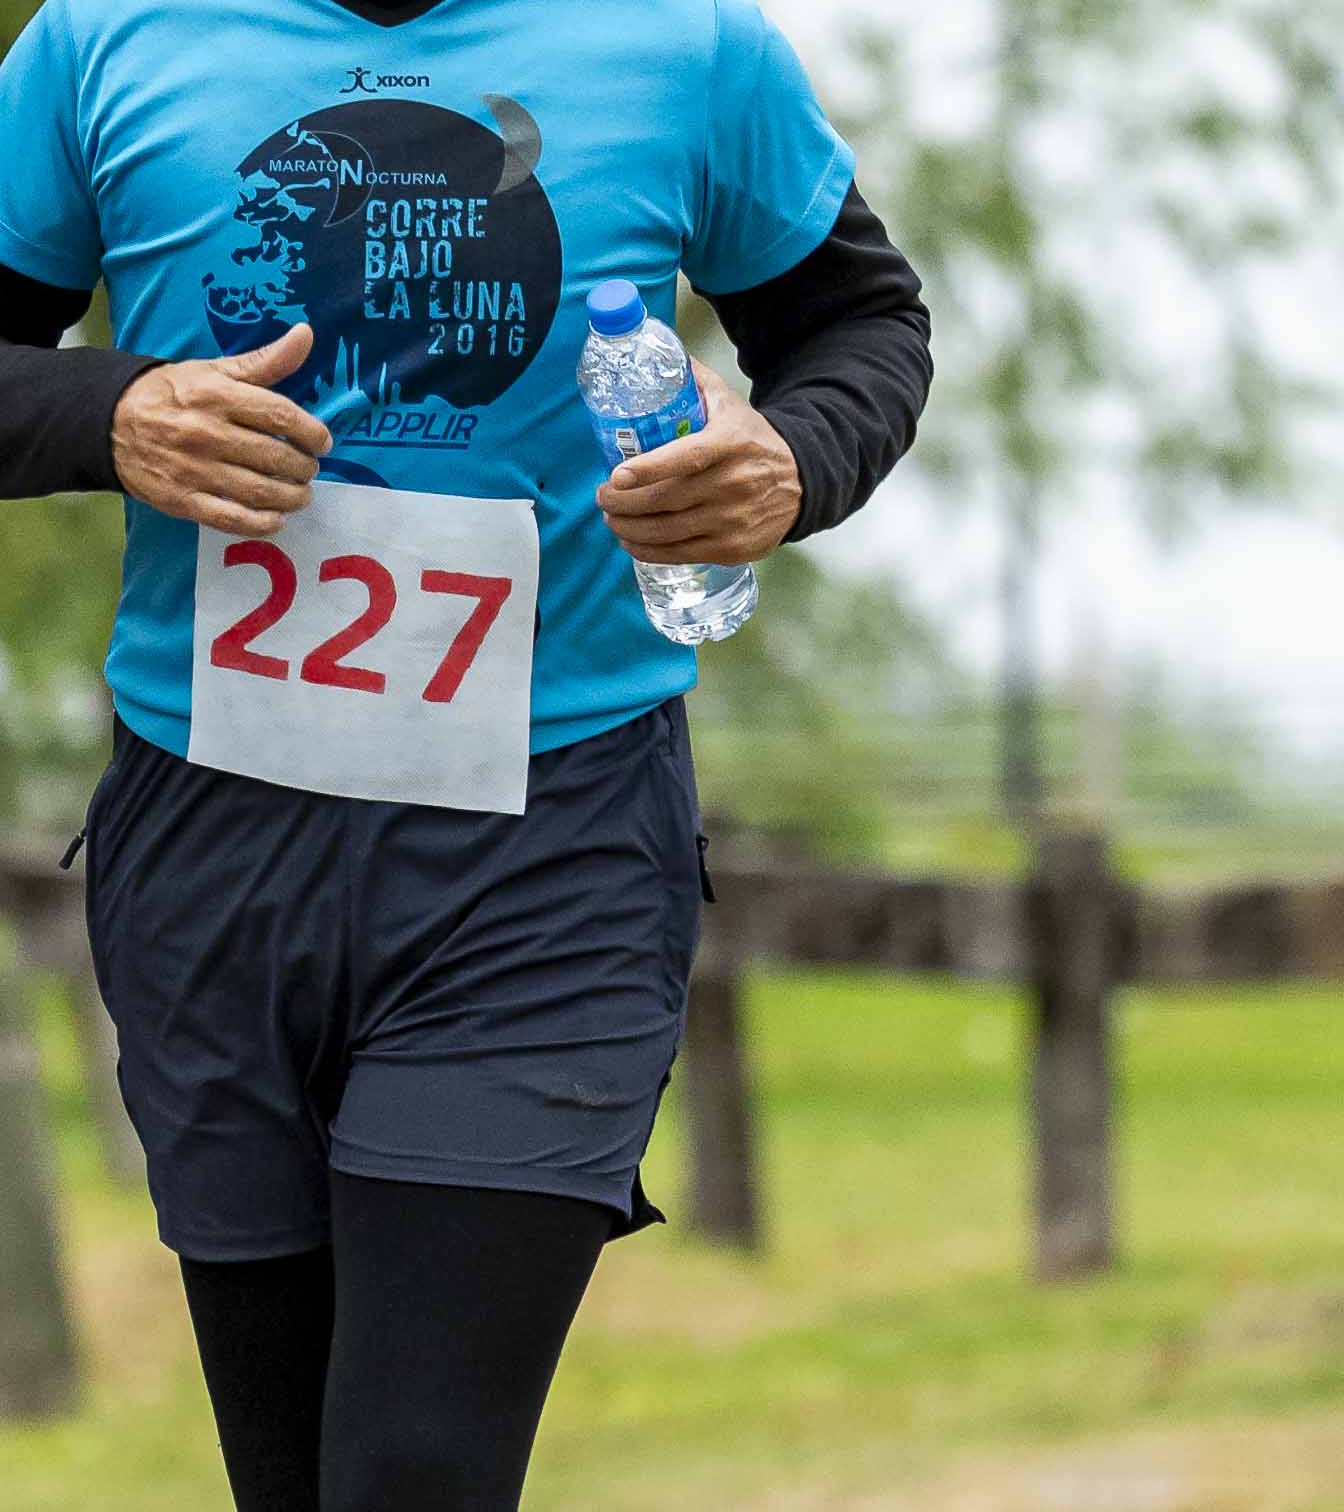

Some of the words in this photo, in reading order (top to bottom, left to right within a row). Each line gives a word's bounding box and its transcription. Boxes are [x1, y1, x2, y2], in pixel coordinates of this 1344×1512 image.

[377, 75, 430, 88] xixon
[366, 199, 488, 238] CORRE
[364, 240, 453, 279] BAJO
[364, 281, 411, 319] LA
[428, 281, 526, 320] LUNA
[428, 323, 526, 357] 2016
[210, 539, 513, 703] 227
